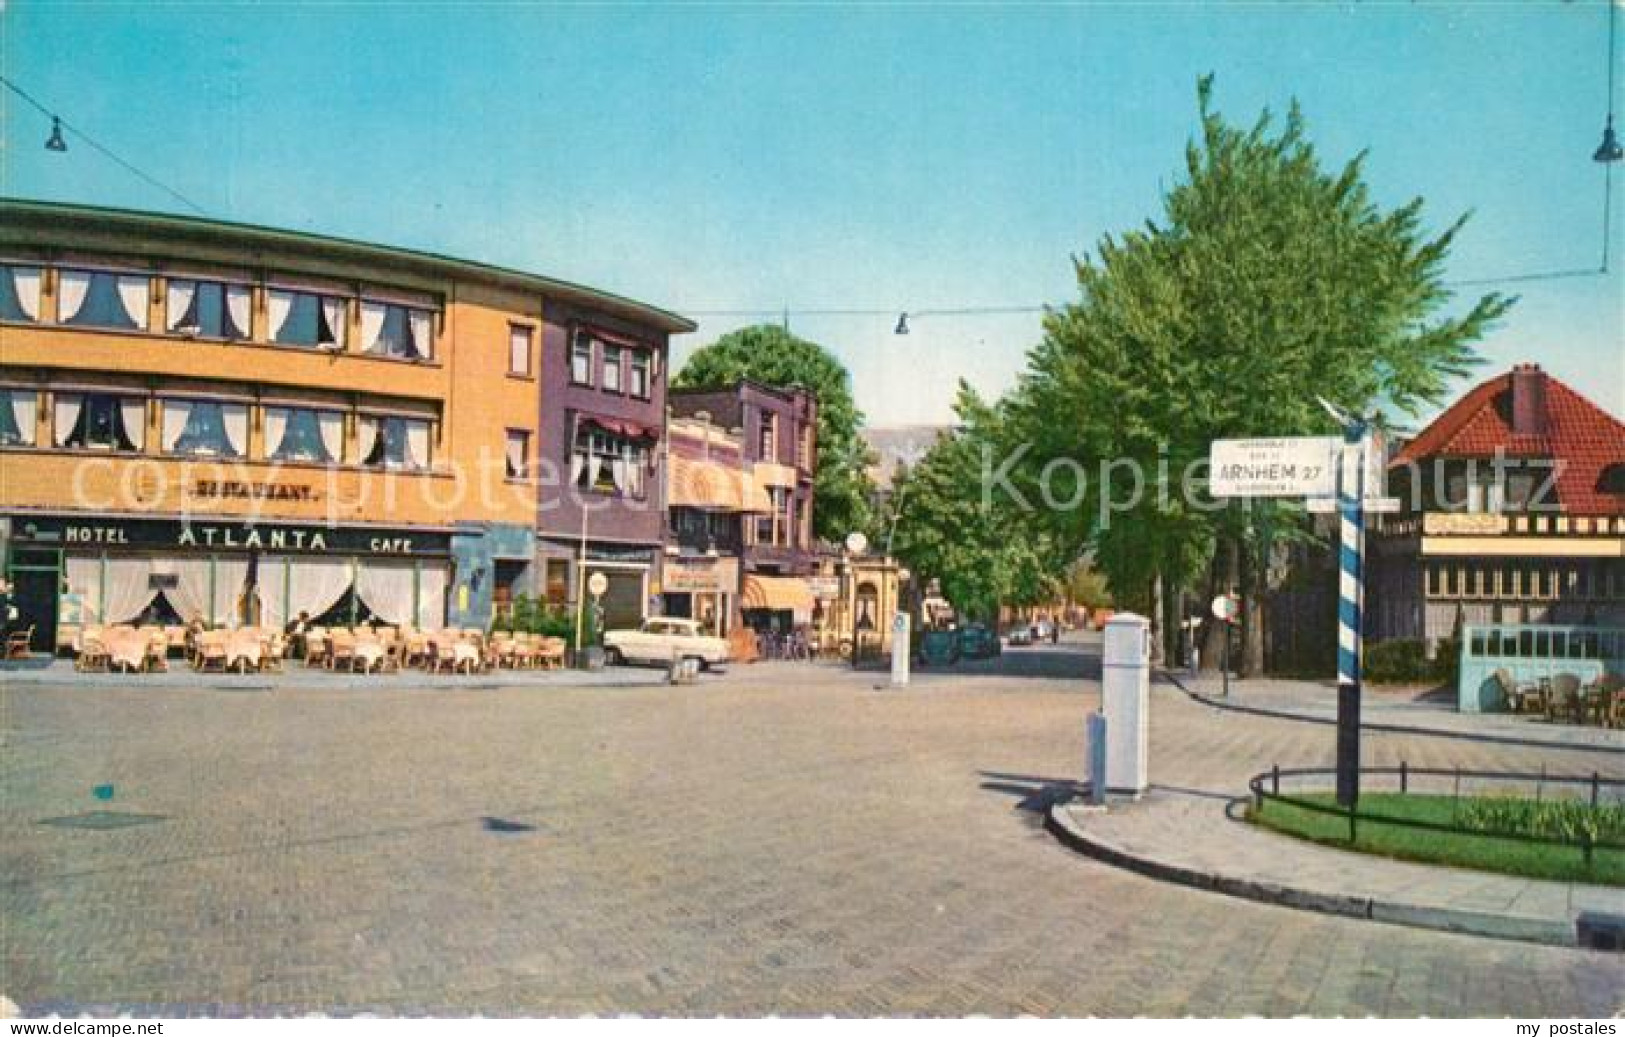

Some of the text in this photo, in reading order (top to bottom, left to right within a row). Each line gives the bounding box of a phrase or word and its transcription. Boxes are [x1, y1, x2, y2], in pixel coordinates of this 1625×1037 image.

[1219, 463, 1297, 481] ARNHEM
[65, 526, 129, 545] HOTEL
[178, 526, 327, 551] ATLANTA
[370, 537, 413, 554] CAFE
